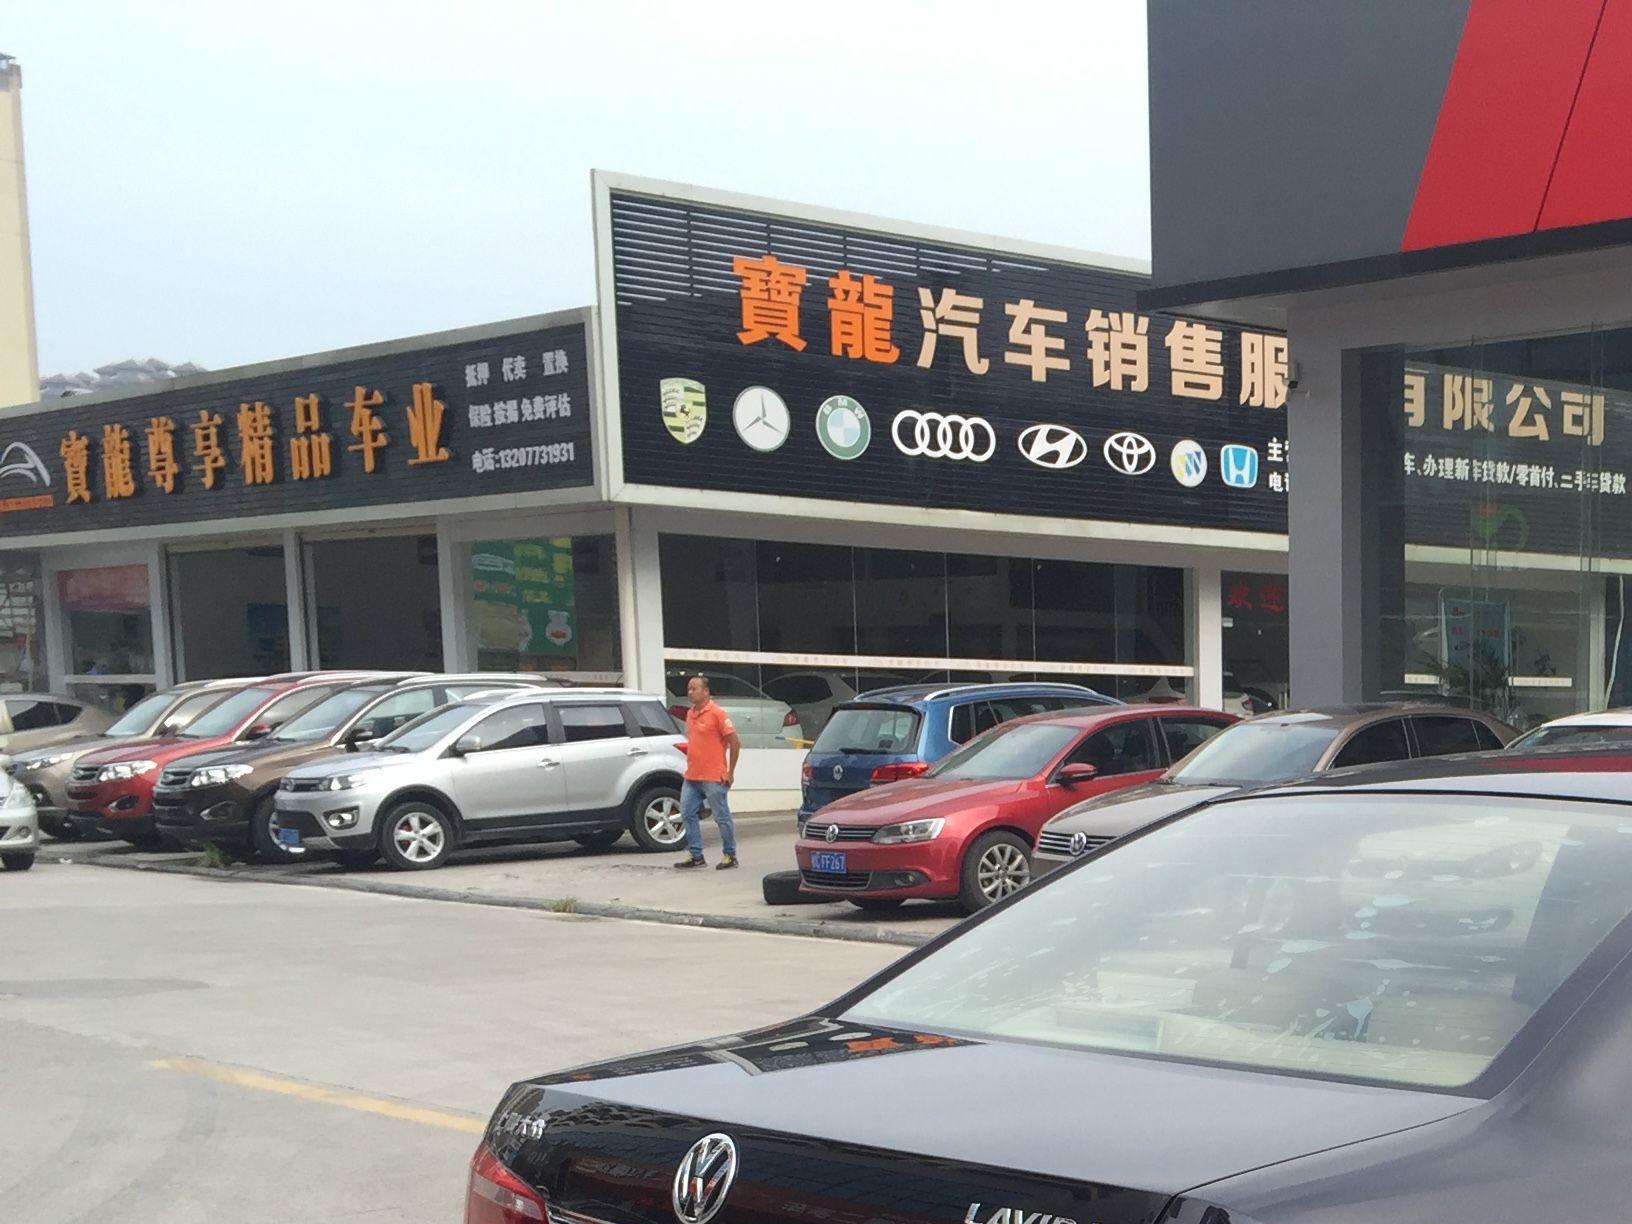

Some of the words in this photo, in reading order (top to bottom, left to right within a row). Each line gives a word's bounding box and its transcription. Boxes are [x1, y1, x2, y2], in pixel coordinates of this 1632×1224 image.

[542, 349, 569, 376] 置换
[521, 392, 571, 421] 免费评估
[59, 381, 451, 503] 寶龍尊享精品车业
[1267, 436, 1289, 463] 主
